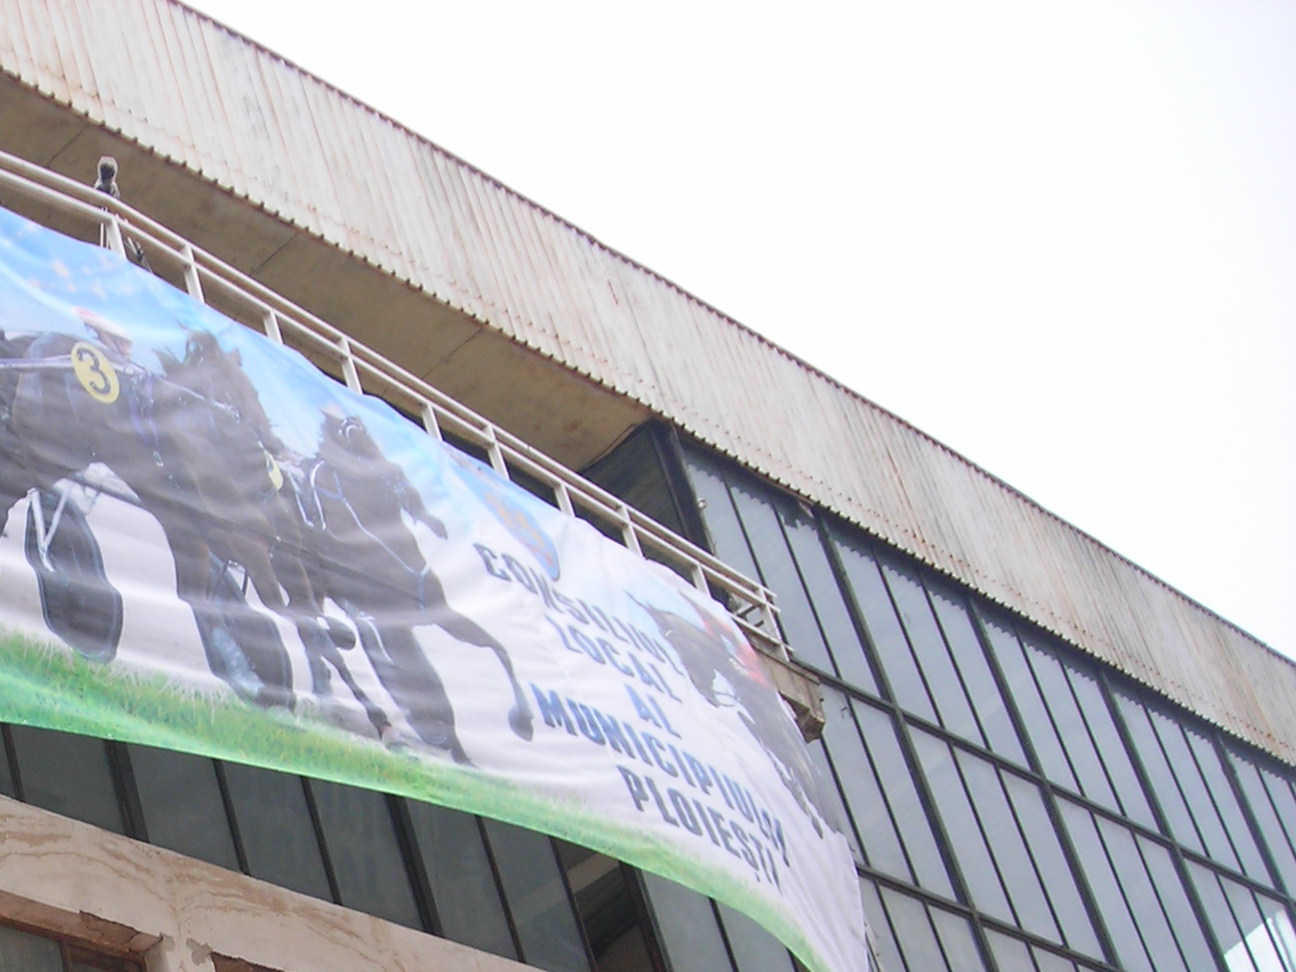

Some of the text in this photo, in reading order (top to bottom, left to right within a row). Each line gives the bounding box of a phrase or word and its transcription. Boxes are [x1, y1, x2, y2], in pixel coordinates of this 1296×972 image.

[75, 347, 113, 395] 3
[472, 542, 685, 677] CONSILIUL
[544, 613, 683, 704] LOCAL
[624, 683, 682, 739] AL
